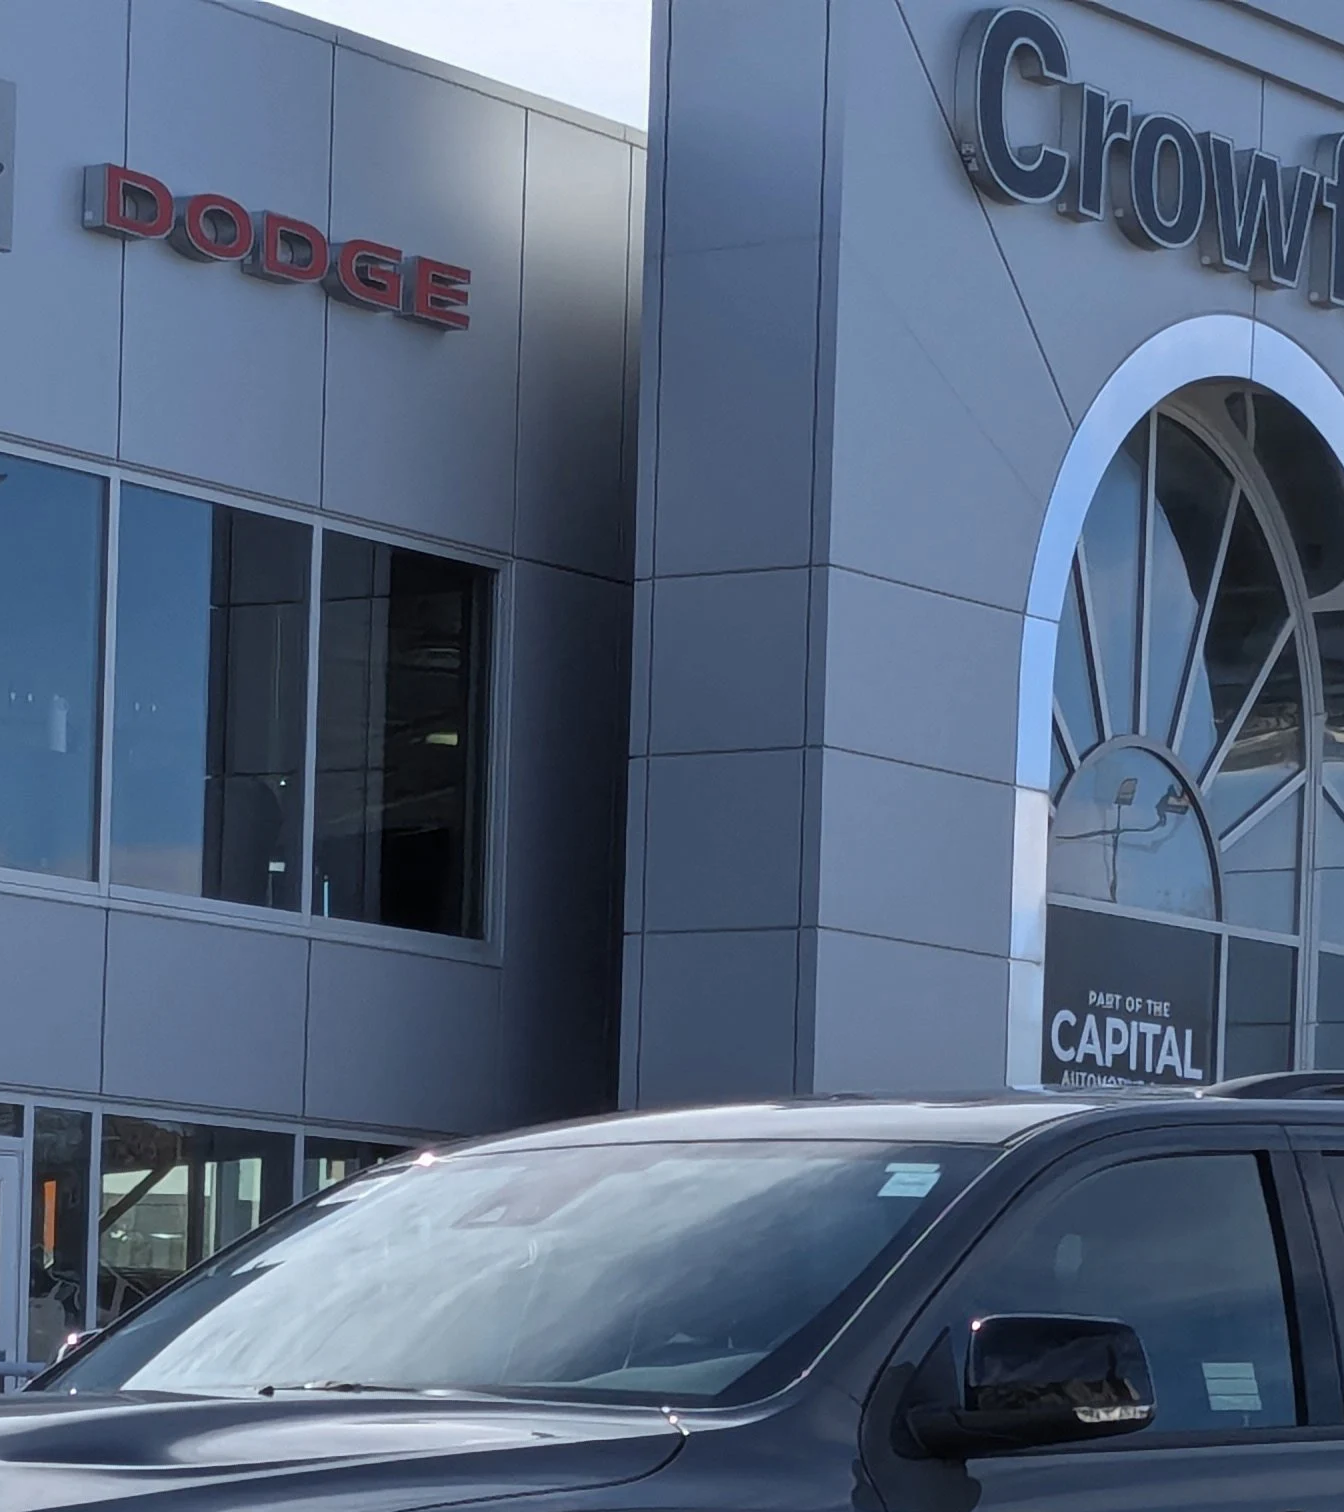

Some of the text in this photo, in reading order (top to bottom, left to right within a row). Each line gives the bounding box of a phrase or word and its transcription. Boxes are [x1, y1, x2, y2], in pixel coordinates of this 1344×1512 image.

[92, 163, 471, 330] DODGE
[1088, 990, 1171, 1018] PART OF THE
[1051, 1009, 1203, 1081] CAPITAL
